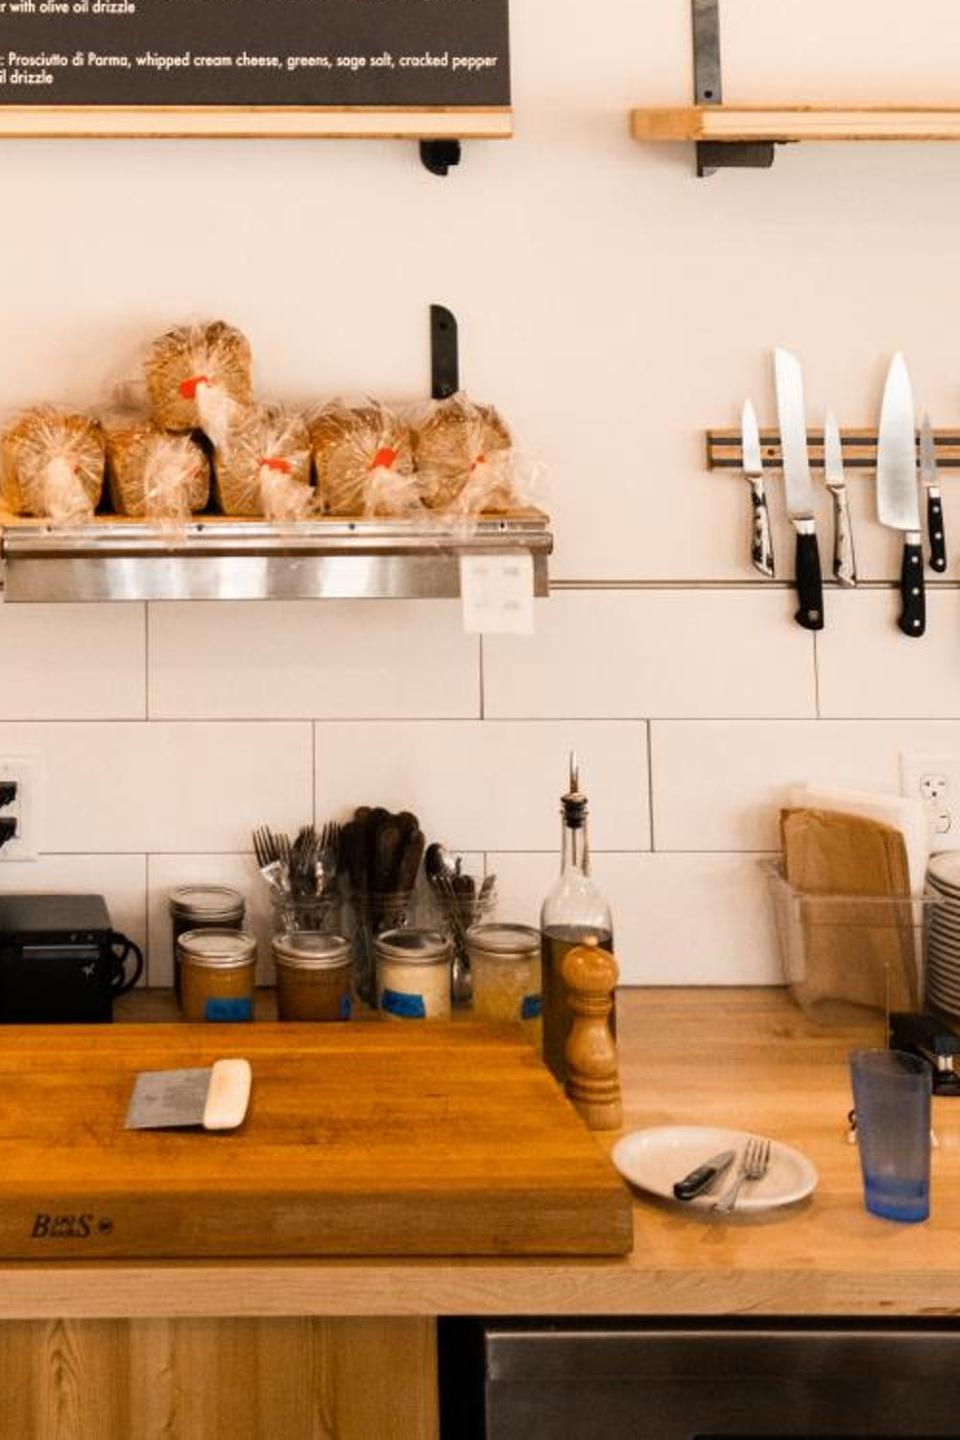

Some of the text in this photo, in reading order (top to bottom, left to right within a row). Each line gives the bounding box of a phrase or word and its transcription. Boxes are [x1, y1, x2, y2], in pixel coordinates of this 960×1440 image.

[72, 52, 84, 66] di
[88, 52, 131, 68] Parma,
[136, 51, 190, 70] whipped
[194, 57, 232, 66] cream
[235, 51, 282, 69] cheese,
[287, 57, 332, 70] greens,
[336, 57, 366, 70] sage
[370, 52, 395, 68] salt,
[399, 52, 448, 66] cracked
[452, 57, 497, 70] pepper
[9, 70, 53, 84] drizzle
